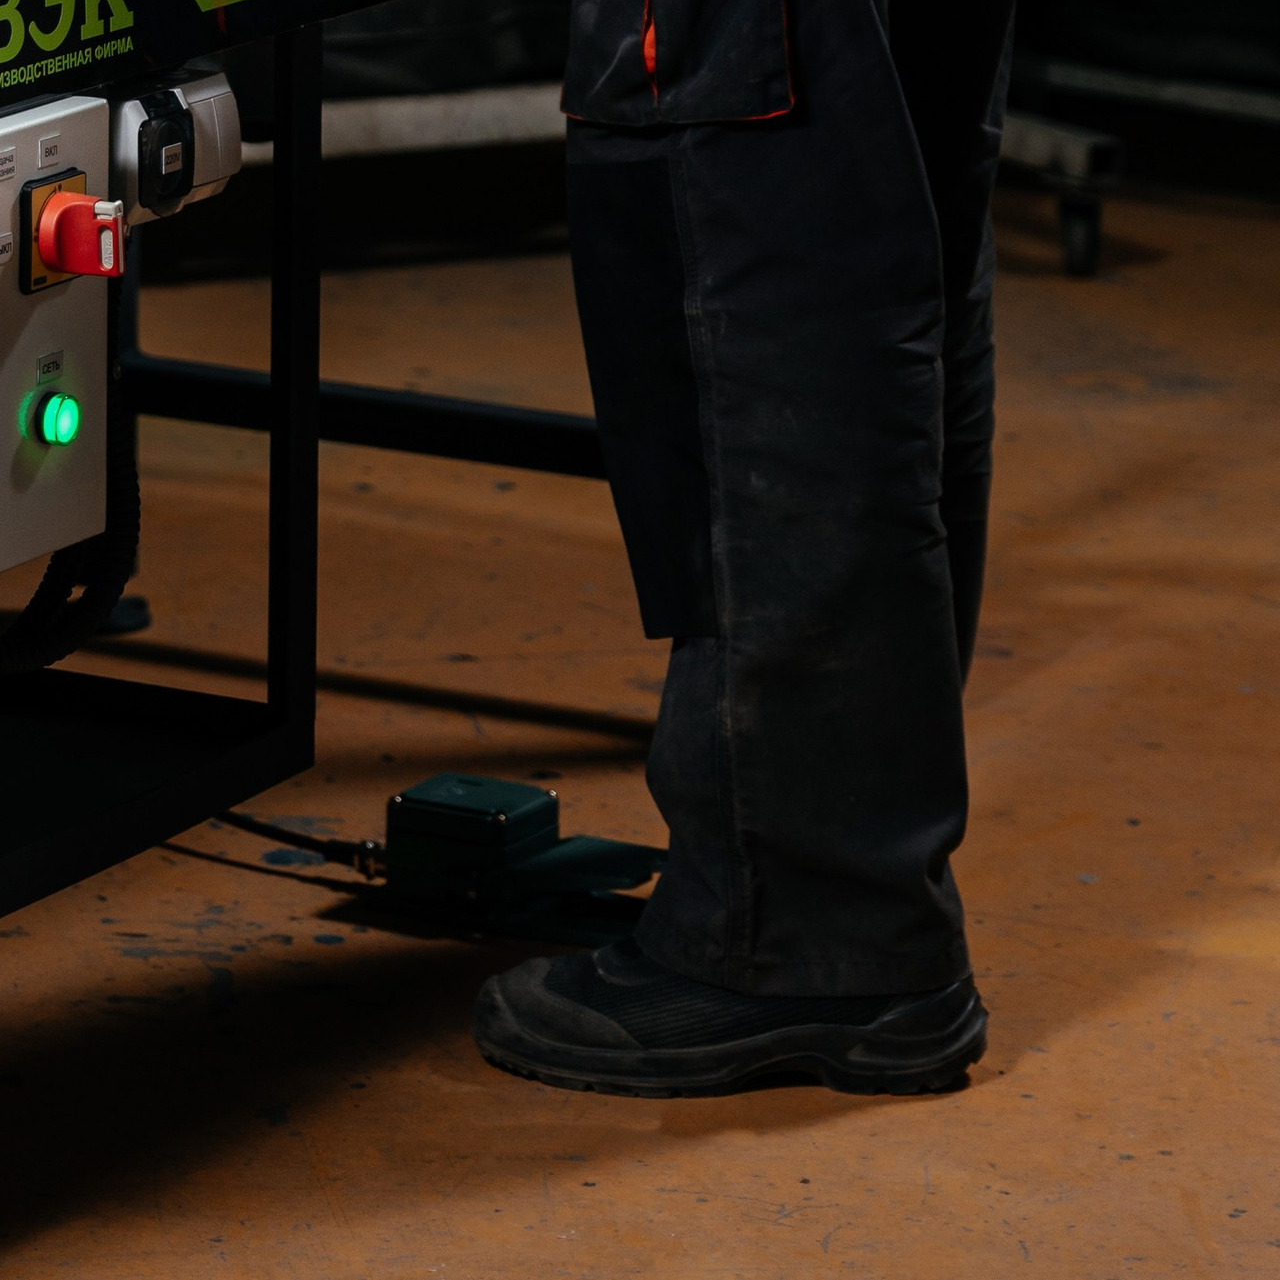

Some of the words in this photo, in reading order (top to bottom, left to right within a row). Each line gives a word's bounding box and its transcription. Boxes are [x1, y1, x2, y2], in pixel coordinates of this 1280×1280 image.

[94, 36, 134, 61] ФИРМА
[44, 144, 58, 158] ВКЛ
[165, 152, 181, 165] 220V
